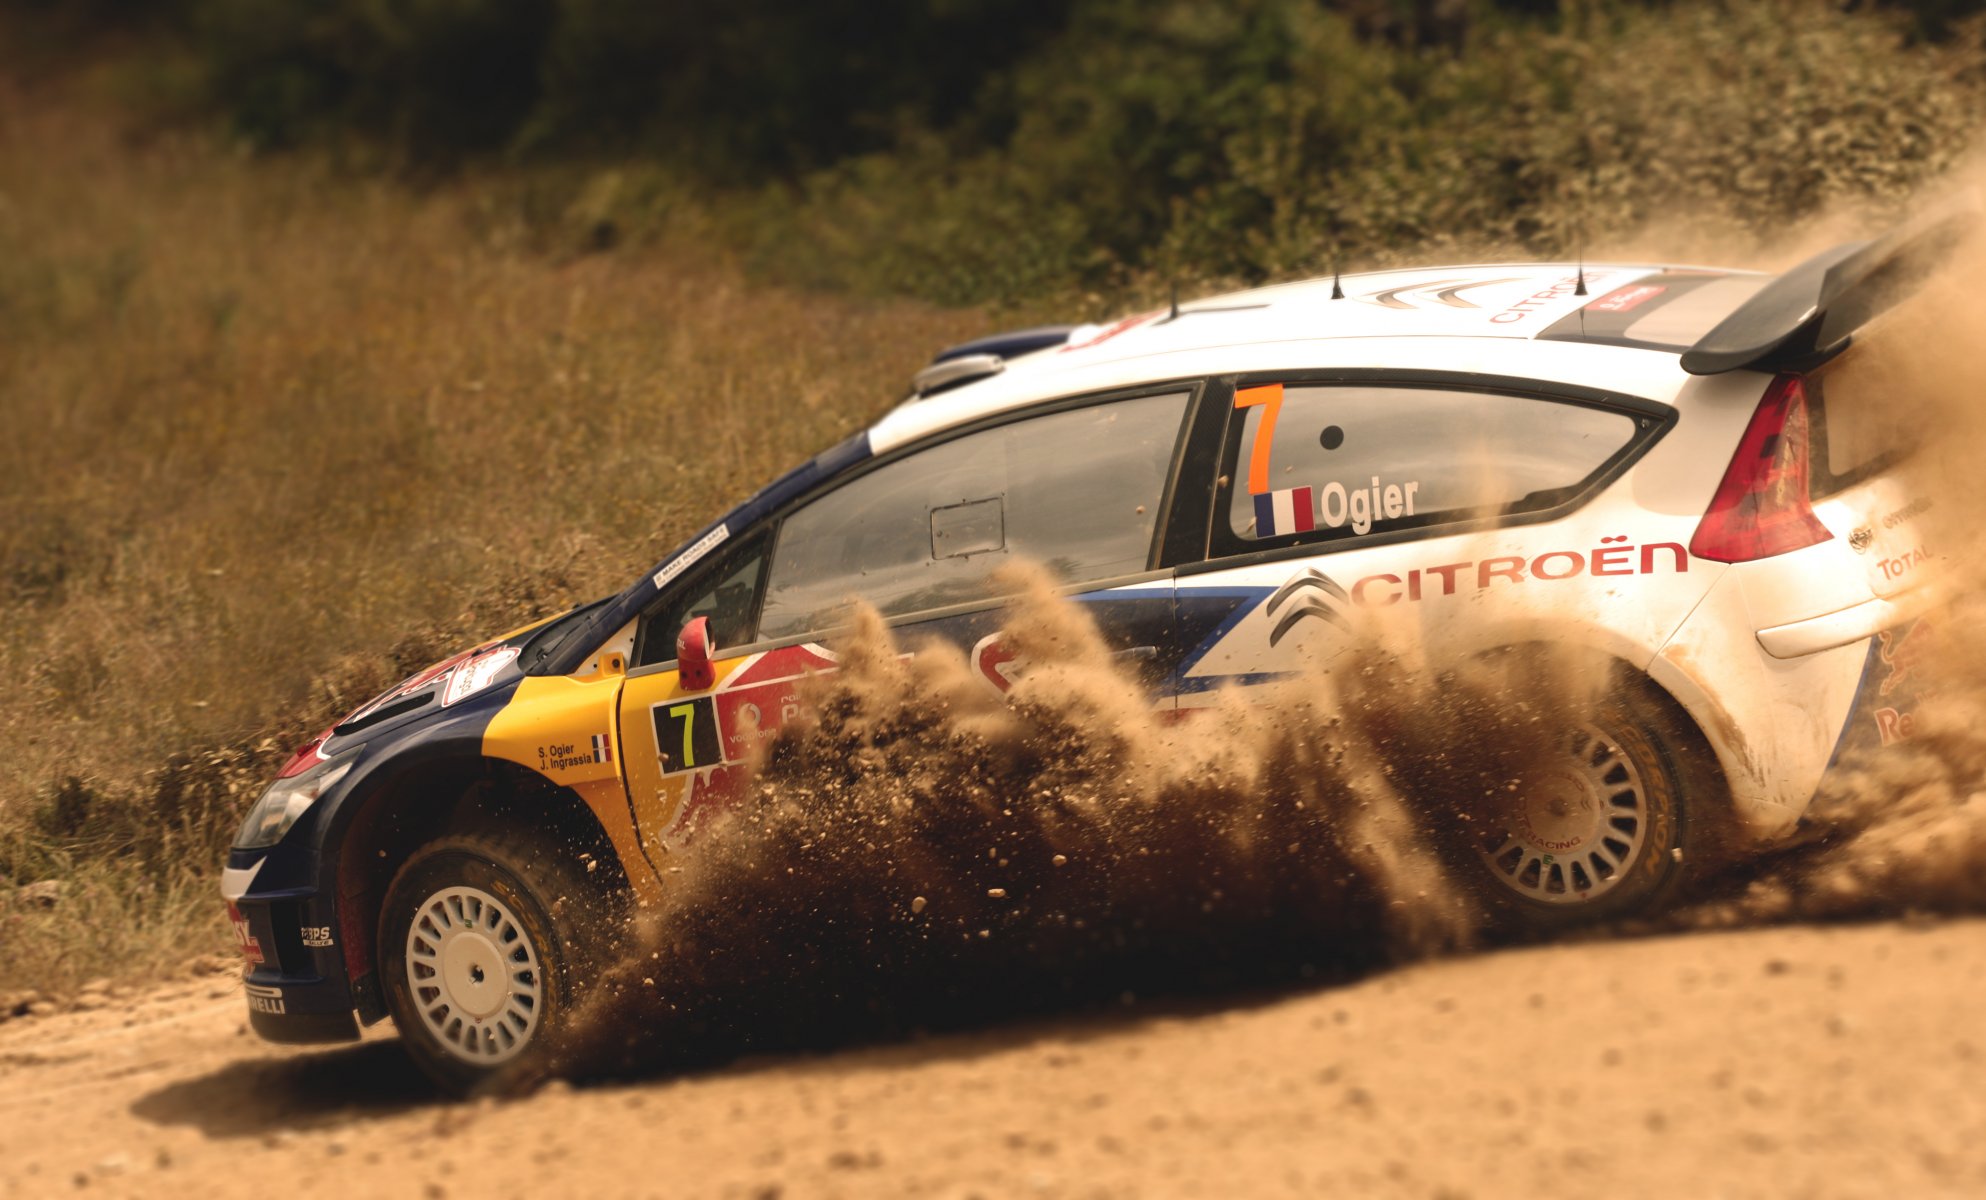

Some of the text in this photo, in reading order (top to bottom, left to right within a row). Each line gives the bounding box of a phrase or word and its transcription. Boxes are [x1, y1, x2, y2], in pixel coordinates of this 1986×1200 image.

[1234, 383, 1284, 495] 7
[1321, 475, 1419, 535] Ogier
[1350, 535, 1689, 608] CITROËN
[1876, 544, 1934, 580] TOTAL
[538, 744, 574, 758] S. Ogier
[669, 703, 695, 768] 7
[1873, 706, 1916, 747] Re
[540, 753, 592, 770] J. Ingrassia
